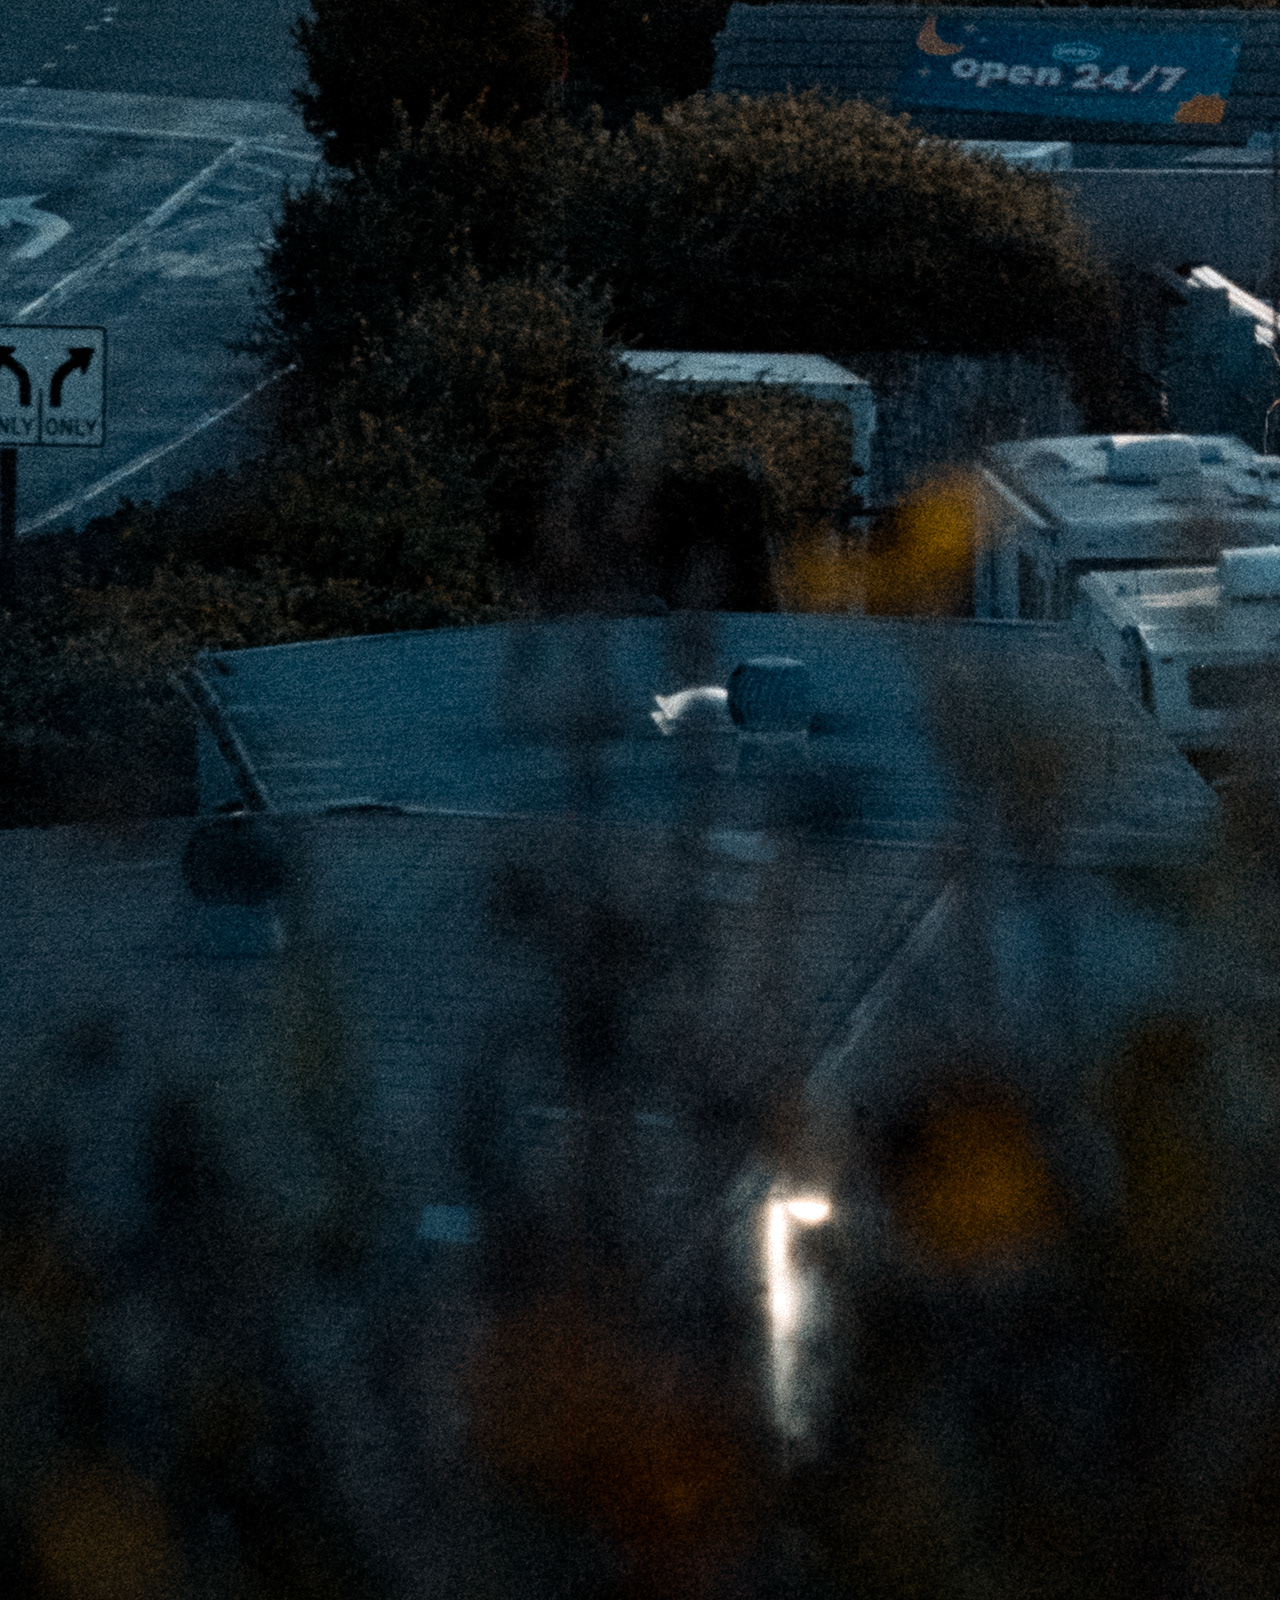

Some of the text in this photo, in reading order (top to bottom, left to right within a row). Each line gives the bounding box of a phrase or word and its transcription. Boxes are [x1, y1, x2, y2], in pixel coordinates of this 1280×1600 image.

[951, 57, 1188, 93] open 24/7
[45, 417, 97, 437] ONLY
